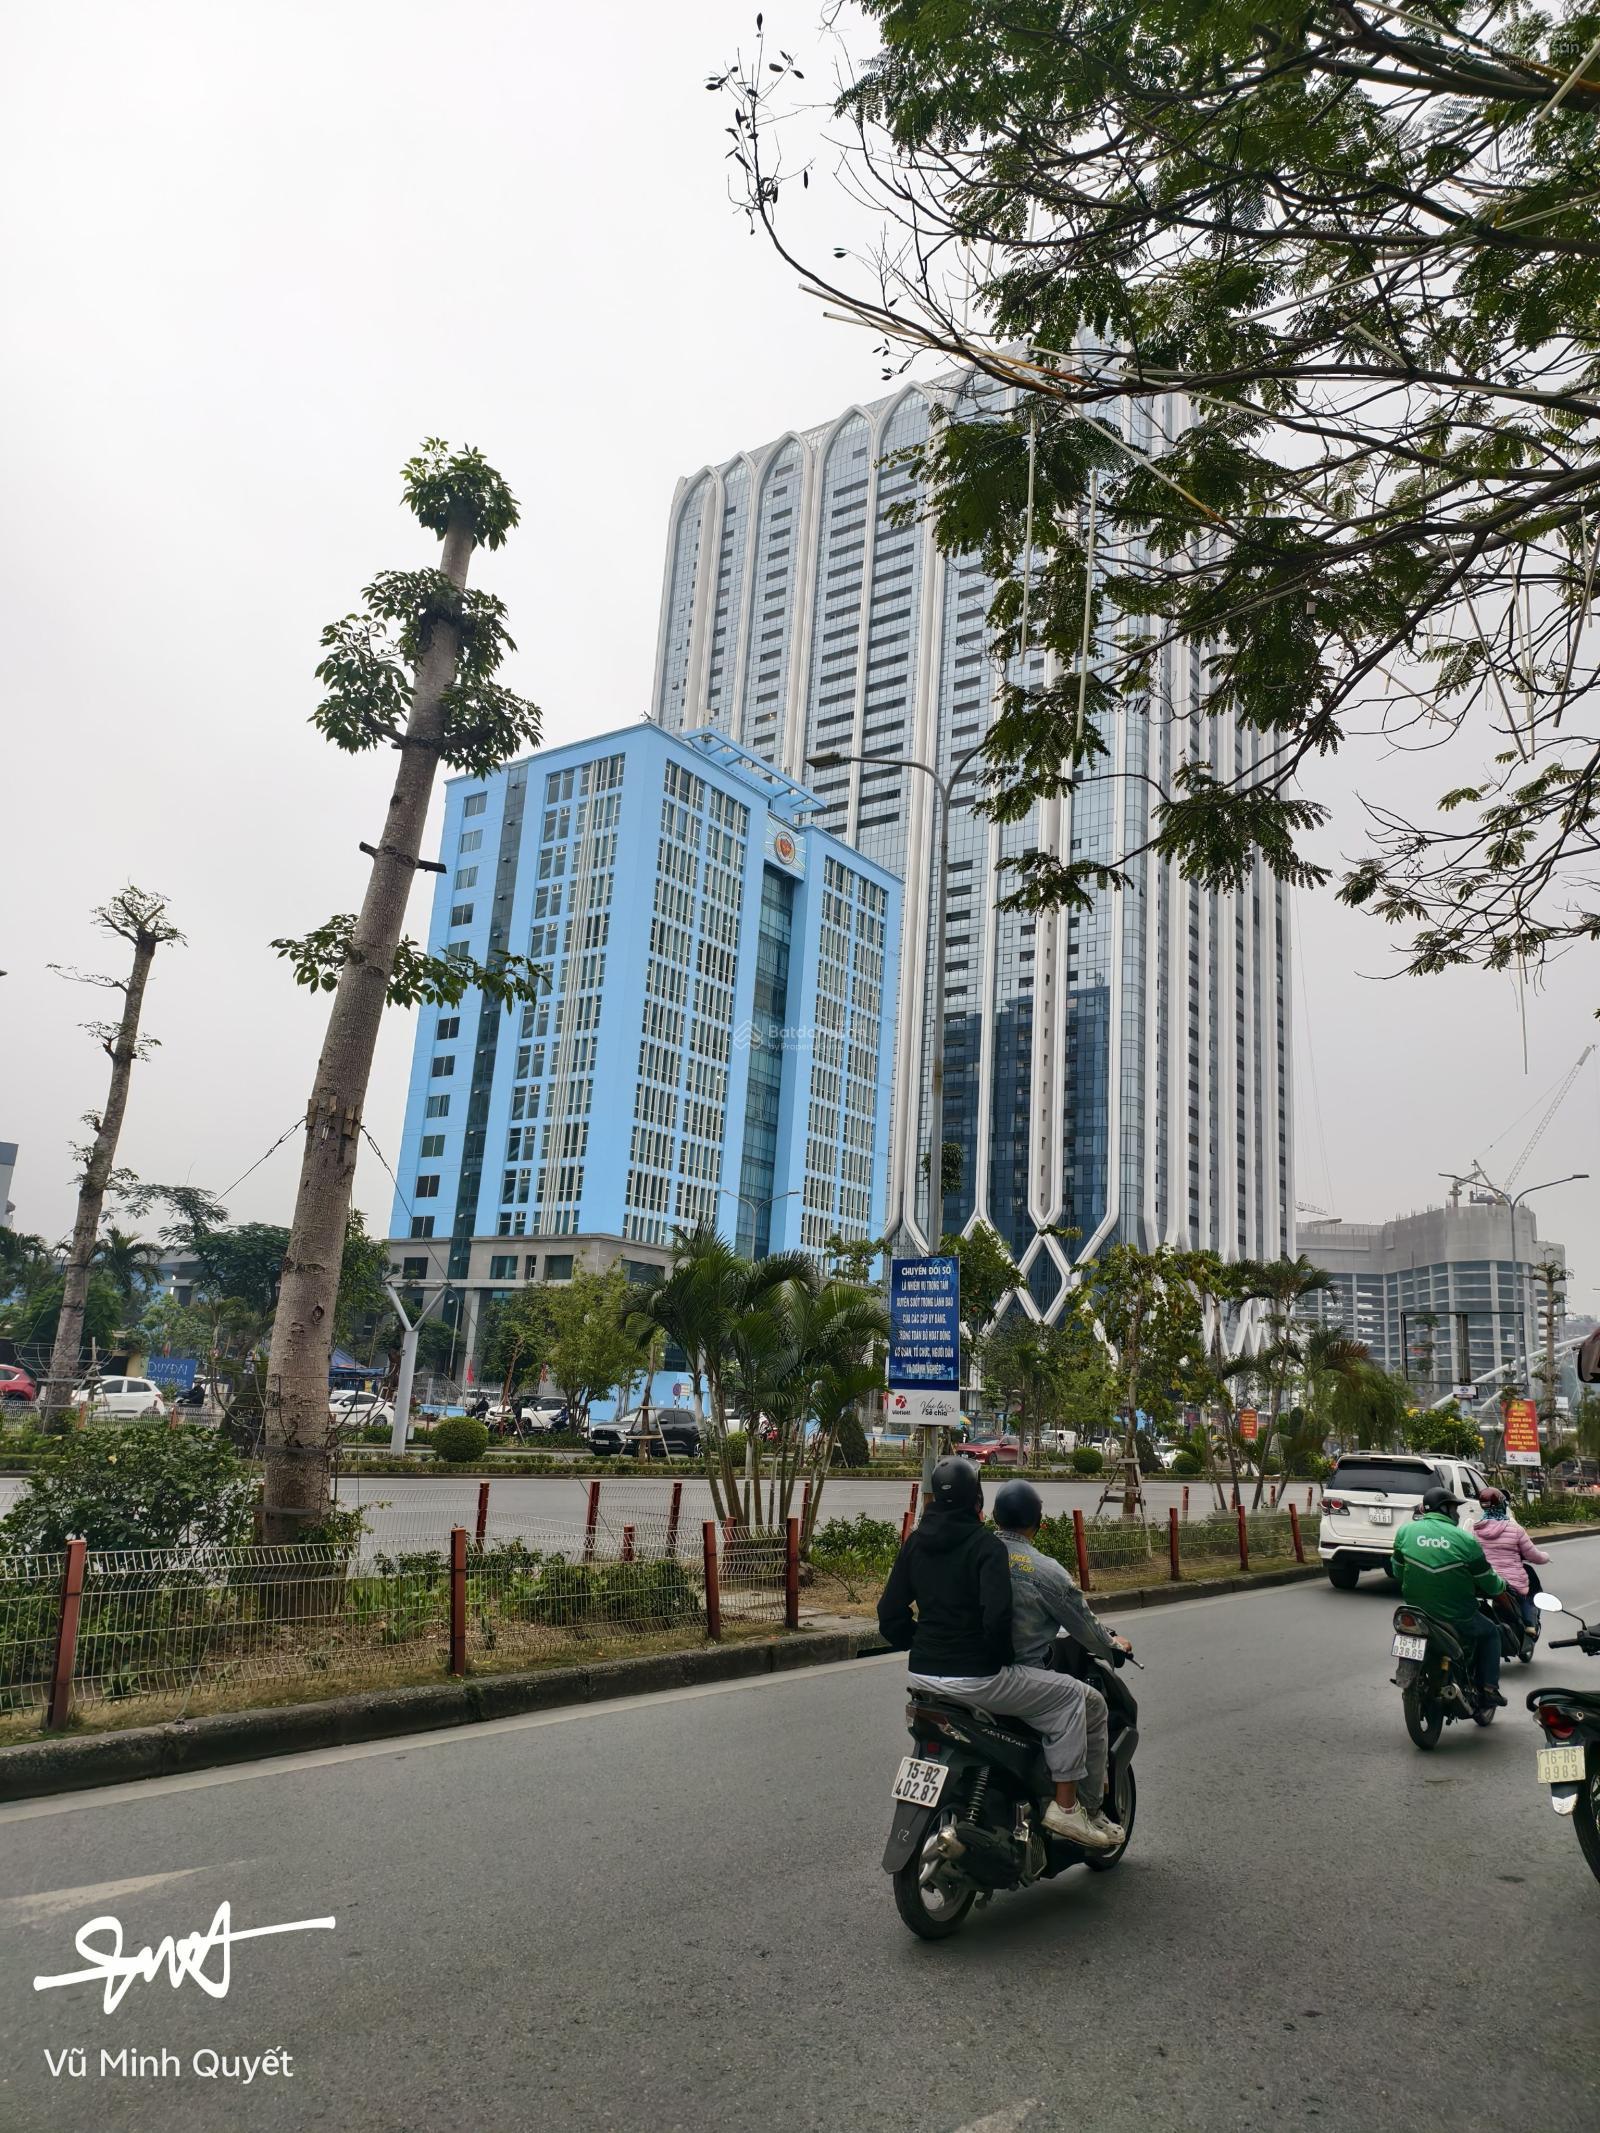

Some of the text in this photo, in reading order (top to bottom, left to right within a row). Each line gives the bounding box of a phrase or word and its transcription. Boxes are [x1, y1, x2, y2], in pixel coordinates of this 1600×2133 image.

[901, 1264, 927, 1276] CHUYỂN
[942, 1264, 952, 1275] SỐ
[1416, 1535, 1450, 1549] Grab
[906, 1762, 940, 1785] 15-B2
[895, 1778, 939, 1803] 402.87
